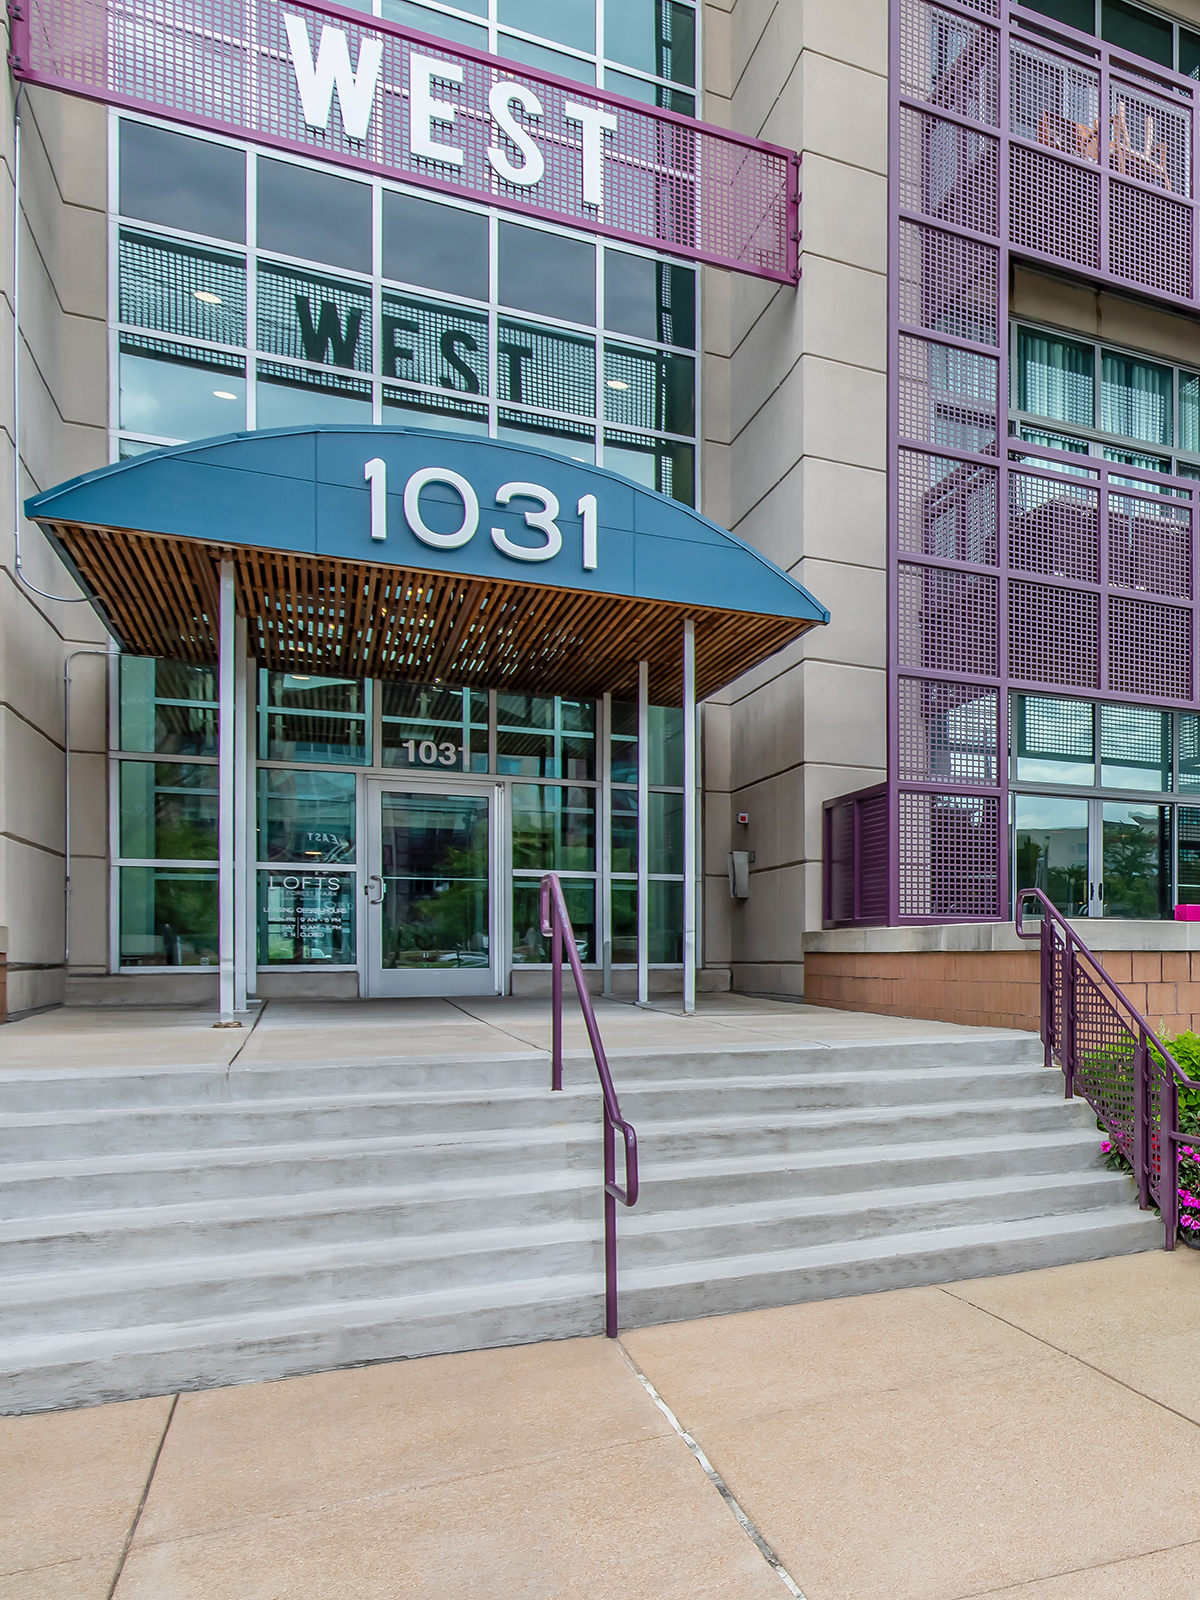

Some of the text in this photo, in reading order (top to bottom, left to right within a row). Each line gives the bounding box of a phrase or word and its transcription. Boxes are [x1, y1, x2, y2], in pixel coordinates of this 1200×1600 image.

[283, 12, 618, 207] WEST
[294, 294, 533, 405] WEST
[364, 457, 598, 570] 1031
[402, 739, 470, 766] 1031
[269, 876, 340, 891] LOFTS
